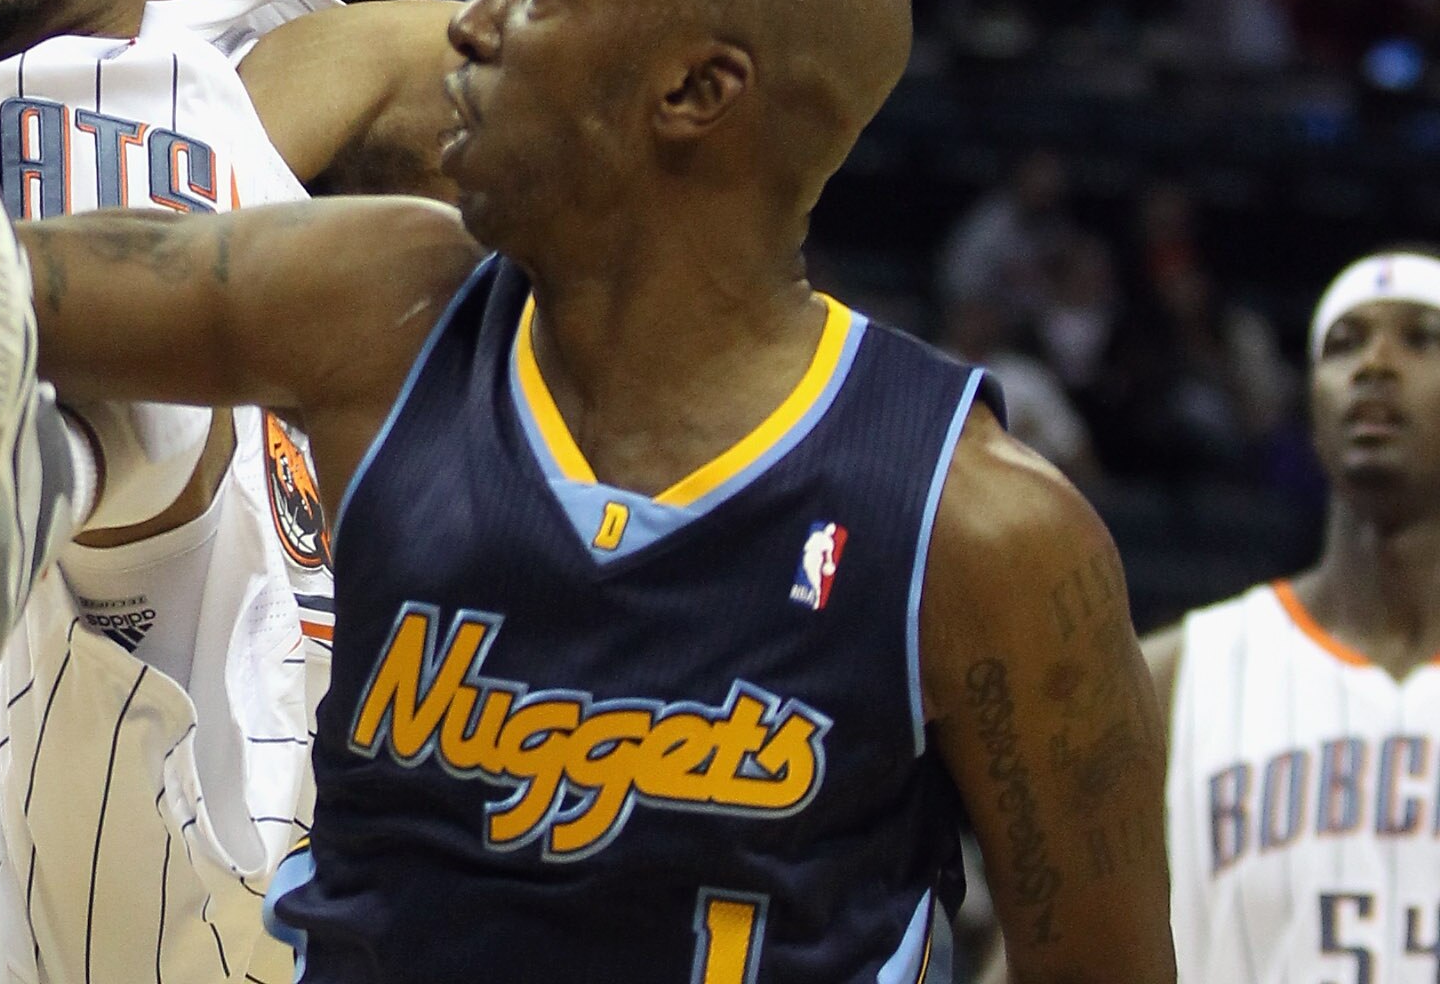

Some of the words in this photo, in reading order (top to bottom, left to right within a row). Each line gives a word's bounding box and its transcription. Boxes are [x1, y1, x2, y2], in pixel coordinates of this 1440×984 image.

[592, 501, 630, 550] D
[85, 609, 156, 630] adidas
[347, 601, 834, 864] Nuggets
[1207, 734, 1440, 879] BOBC
[691, 886, 770, 984] 1
